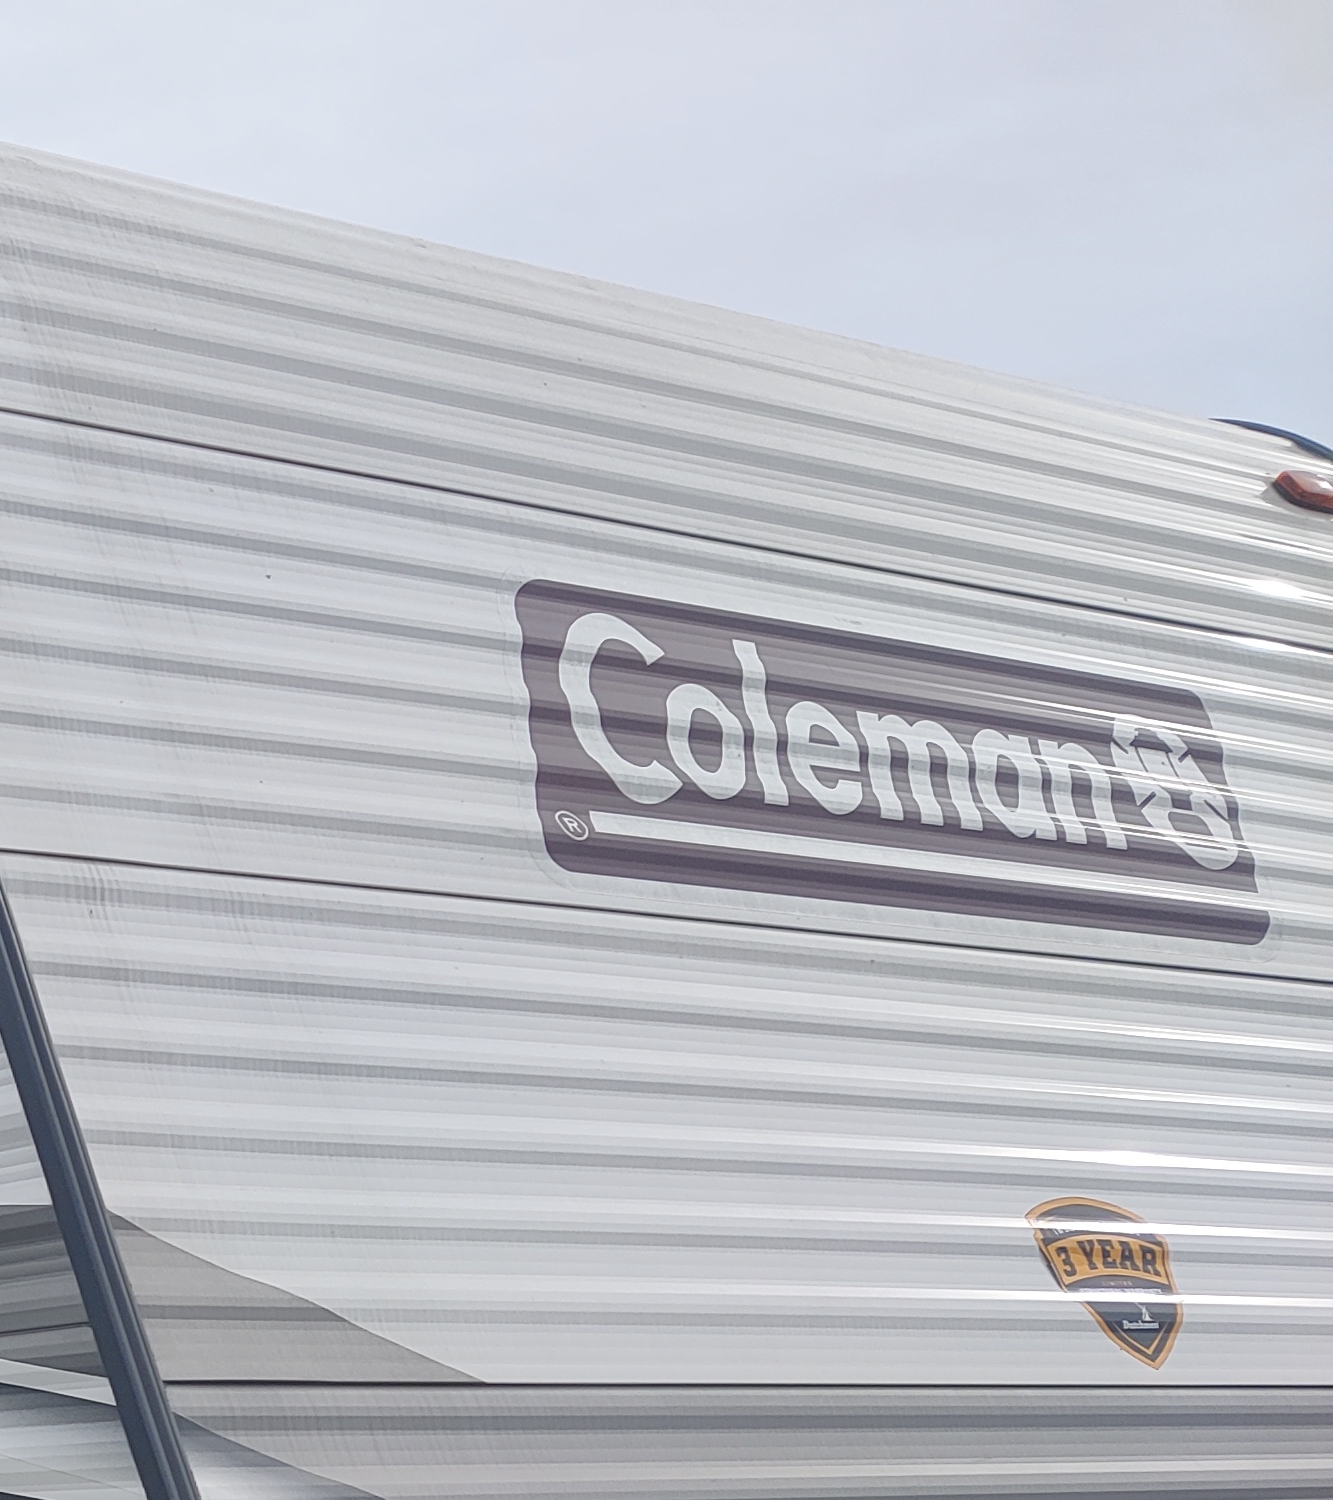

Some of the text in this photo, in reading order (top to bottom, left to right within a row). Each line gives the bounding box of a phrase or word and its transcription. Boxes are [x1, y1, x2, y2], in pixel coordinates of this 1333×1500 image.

[557, 612, 1129, 852] Coleman
[1055, 1238, 1163, 1278] 3 YEAR
